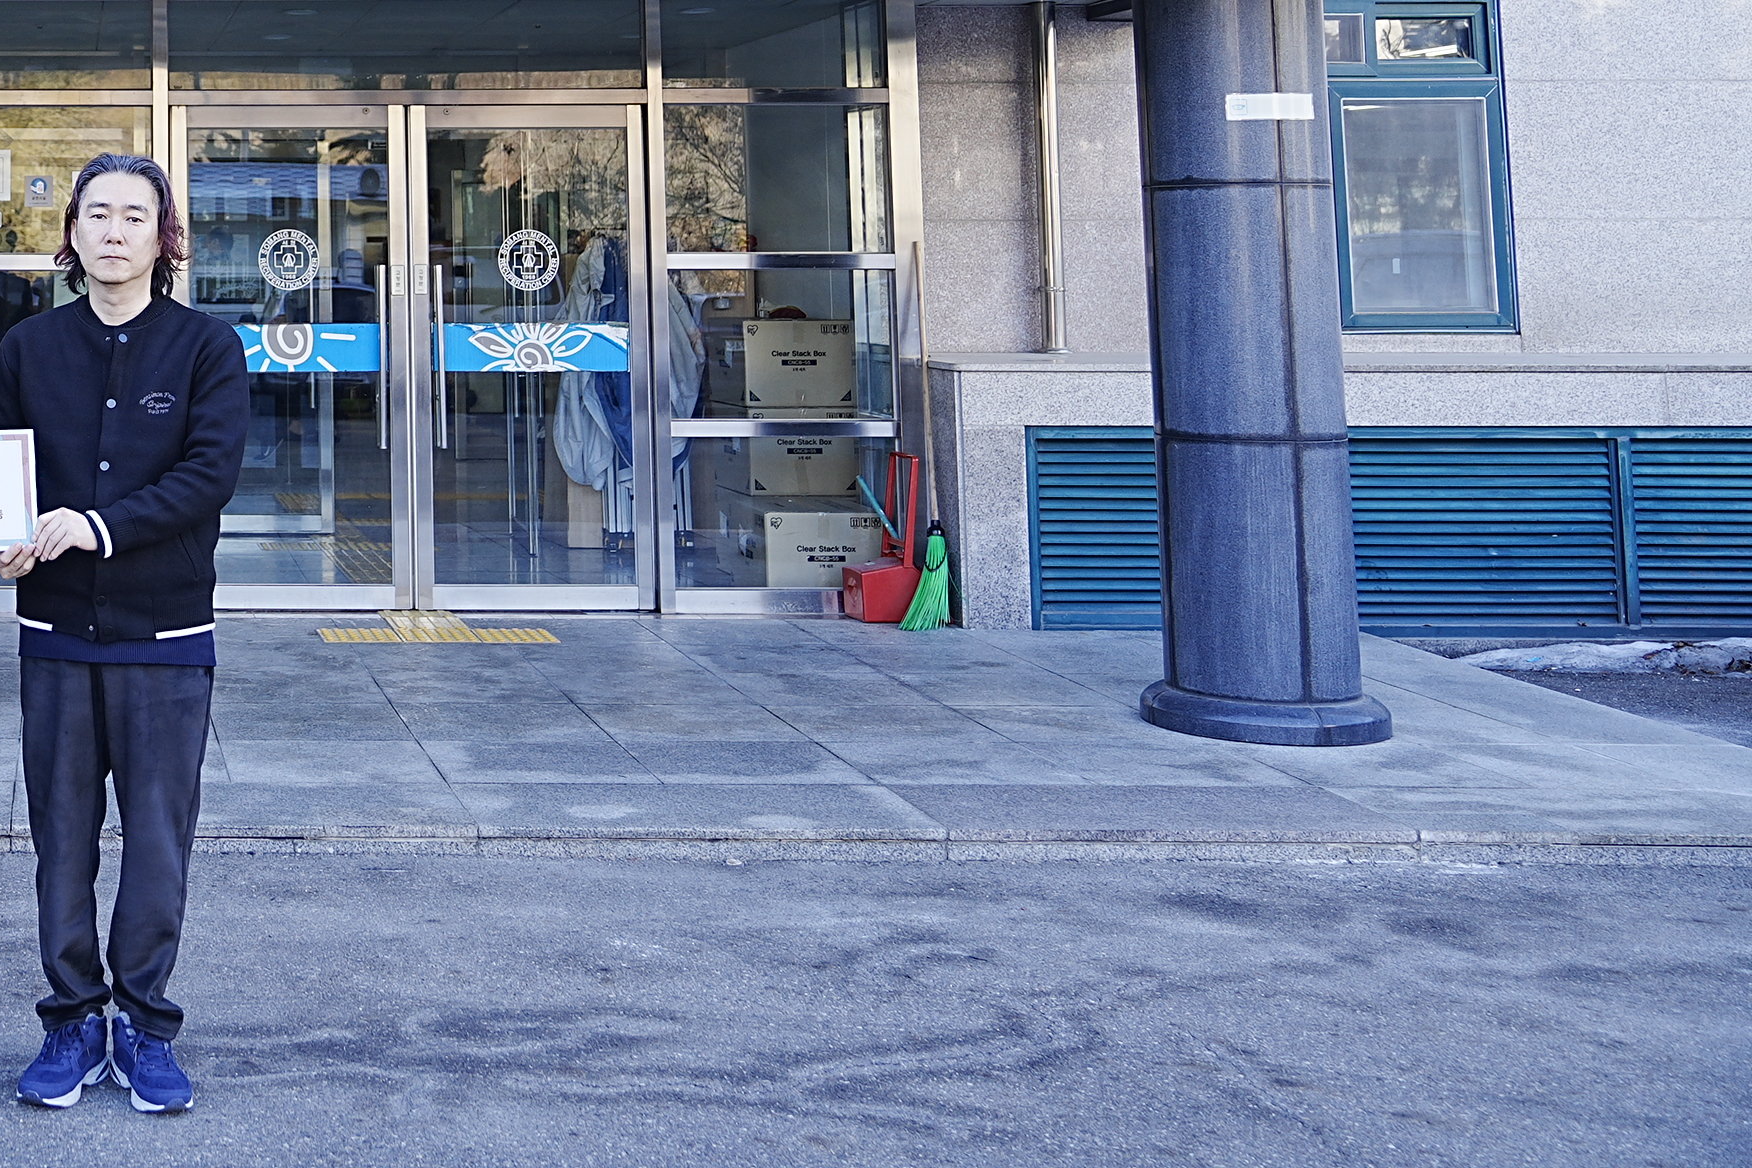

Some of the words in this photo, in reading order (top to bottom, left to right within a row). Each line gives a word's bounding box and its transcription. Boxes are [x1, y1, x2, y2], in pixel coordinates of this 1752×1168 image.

[261, 232, 289, 255] SOMANG
[290, 232, 316, 255] MENTAL
[500, 232, 528, 255] SOMANG
[530, 232, 556, 255] MENTAL
[796, 545, 816, 553] Clear
[818, 545, 840, 553] Stack
[841, 545, 856, 553] Box
